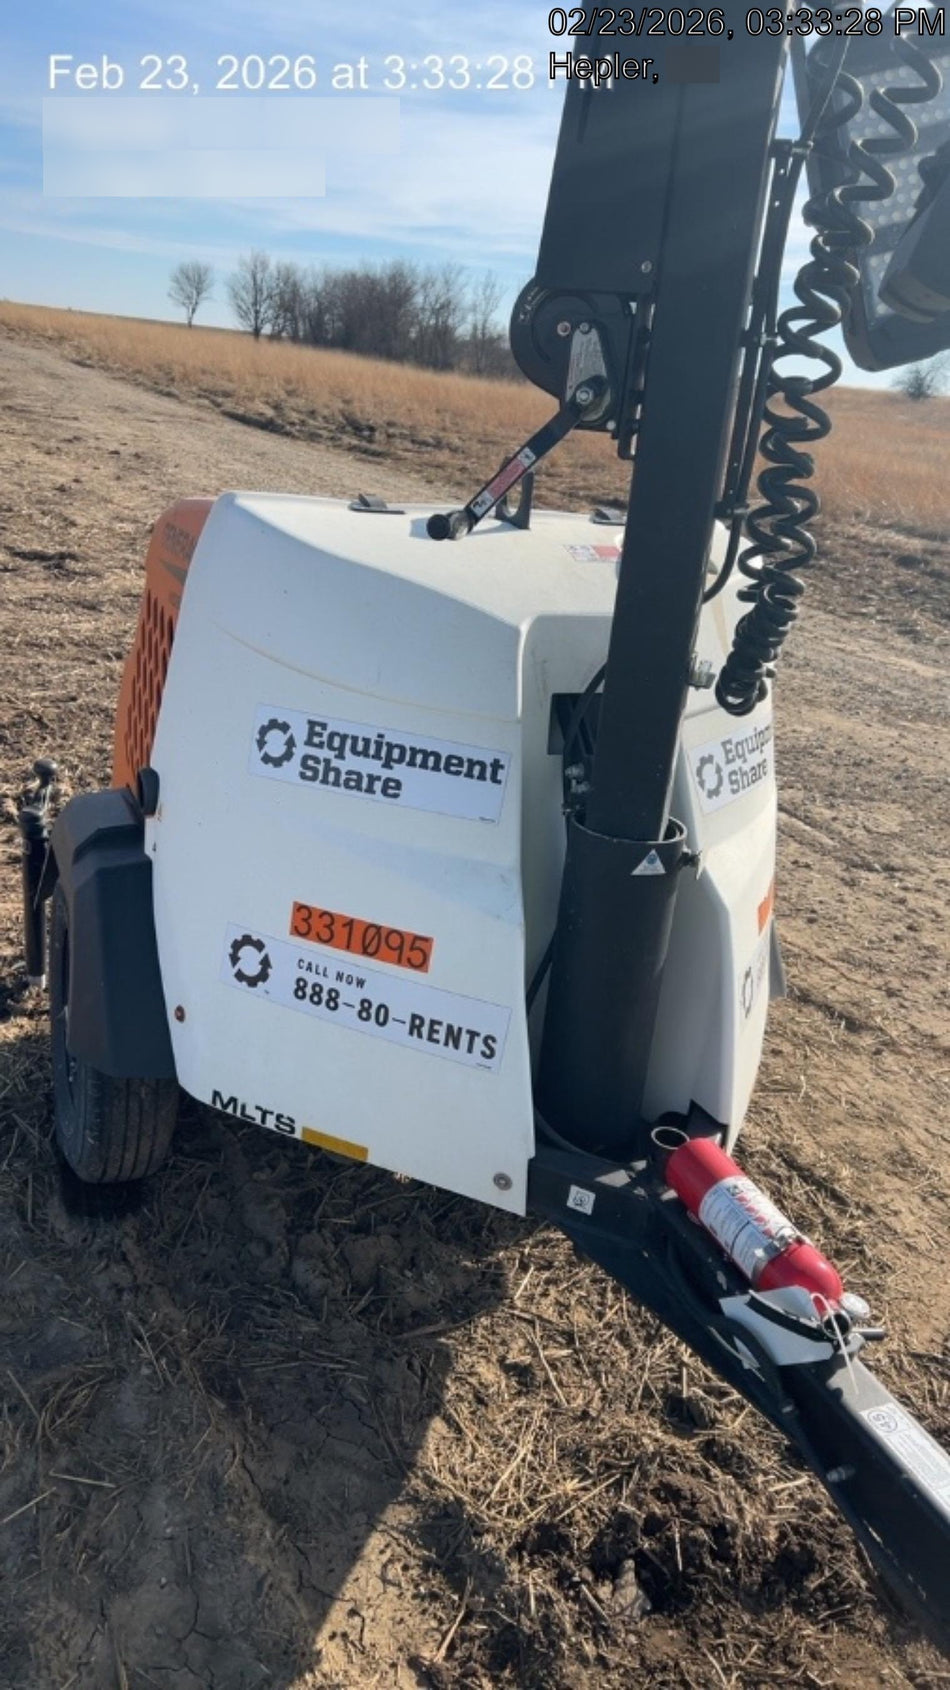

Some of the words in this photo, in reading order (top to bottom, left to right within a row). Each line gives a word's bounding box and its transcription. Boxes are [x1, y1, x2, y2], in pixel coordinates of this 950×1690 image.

[299, 753, 402, 800] Share
[303, 719, 505, 785] Equipment
[293, 904, 431, 969] 331095
[298, 958, 329, 979] CALL
[335, 970, 367, 990] NOW
[293, 977, 498, 1061] 888-80-RENTS
[211, 1089, 296, 1135] MLTS
